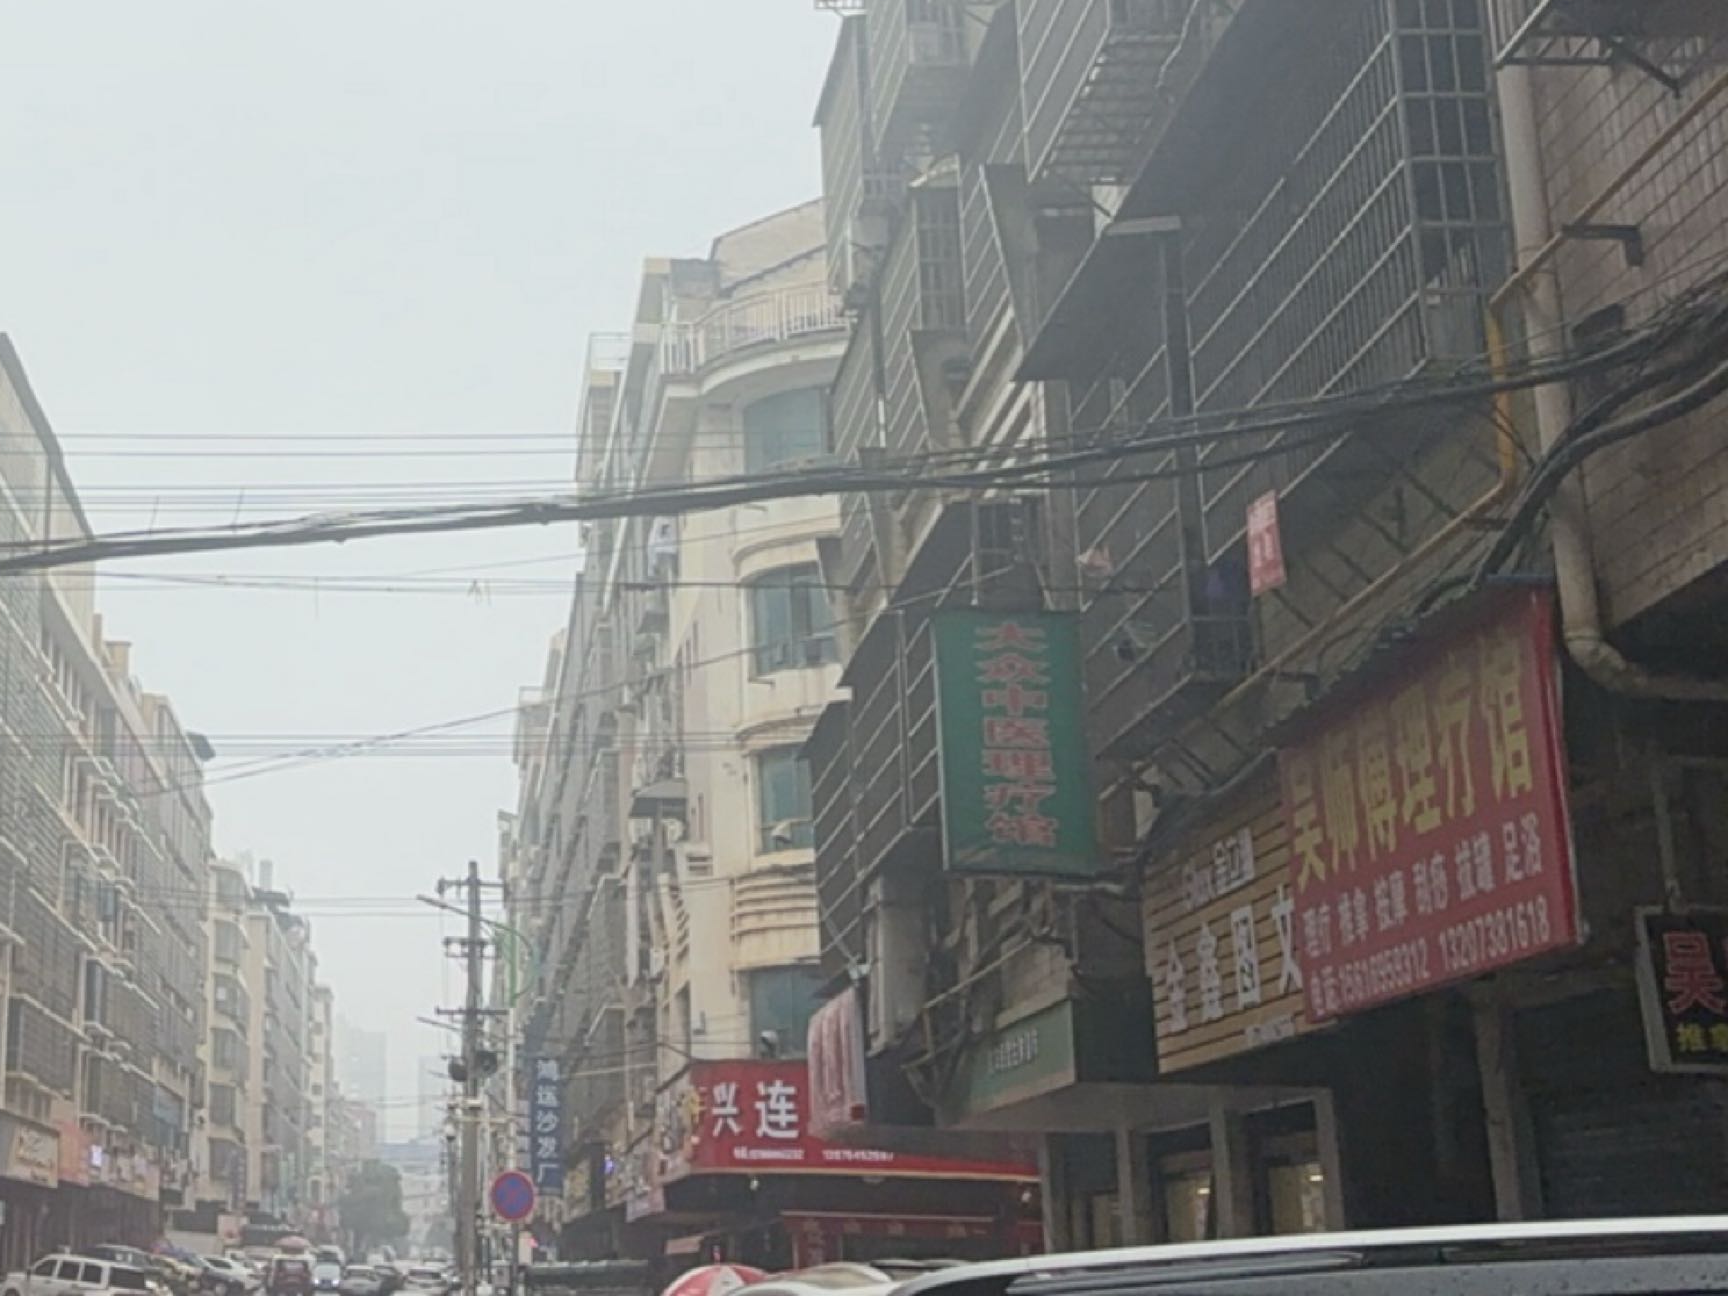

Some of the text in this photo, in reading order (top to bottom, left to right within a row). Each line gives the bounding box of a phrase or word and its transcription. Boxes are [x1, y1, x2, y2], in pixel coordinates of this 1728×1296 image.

[972, 621, 1059, 847] 大众中医理疗馆
[1290, 626, 1533, 893] 吴师傅理疗馆
[1502, 811, 1543, 883] 足浴
[1663, 931, 1728, 1015] 吴
